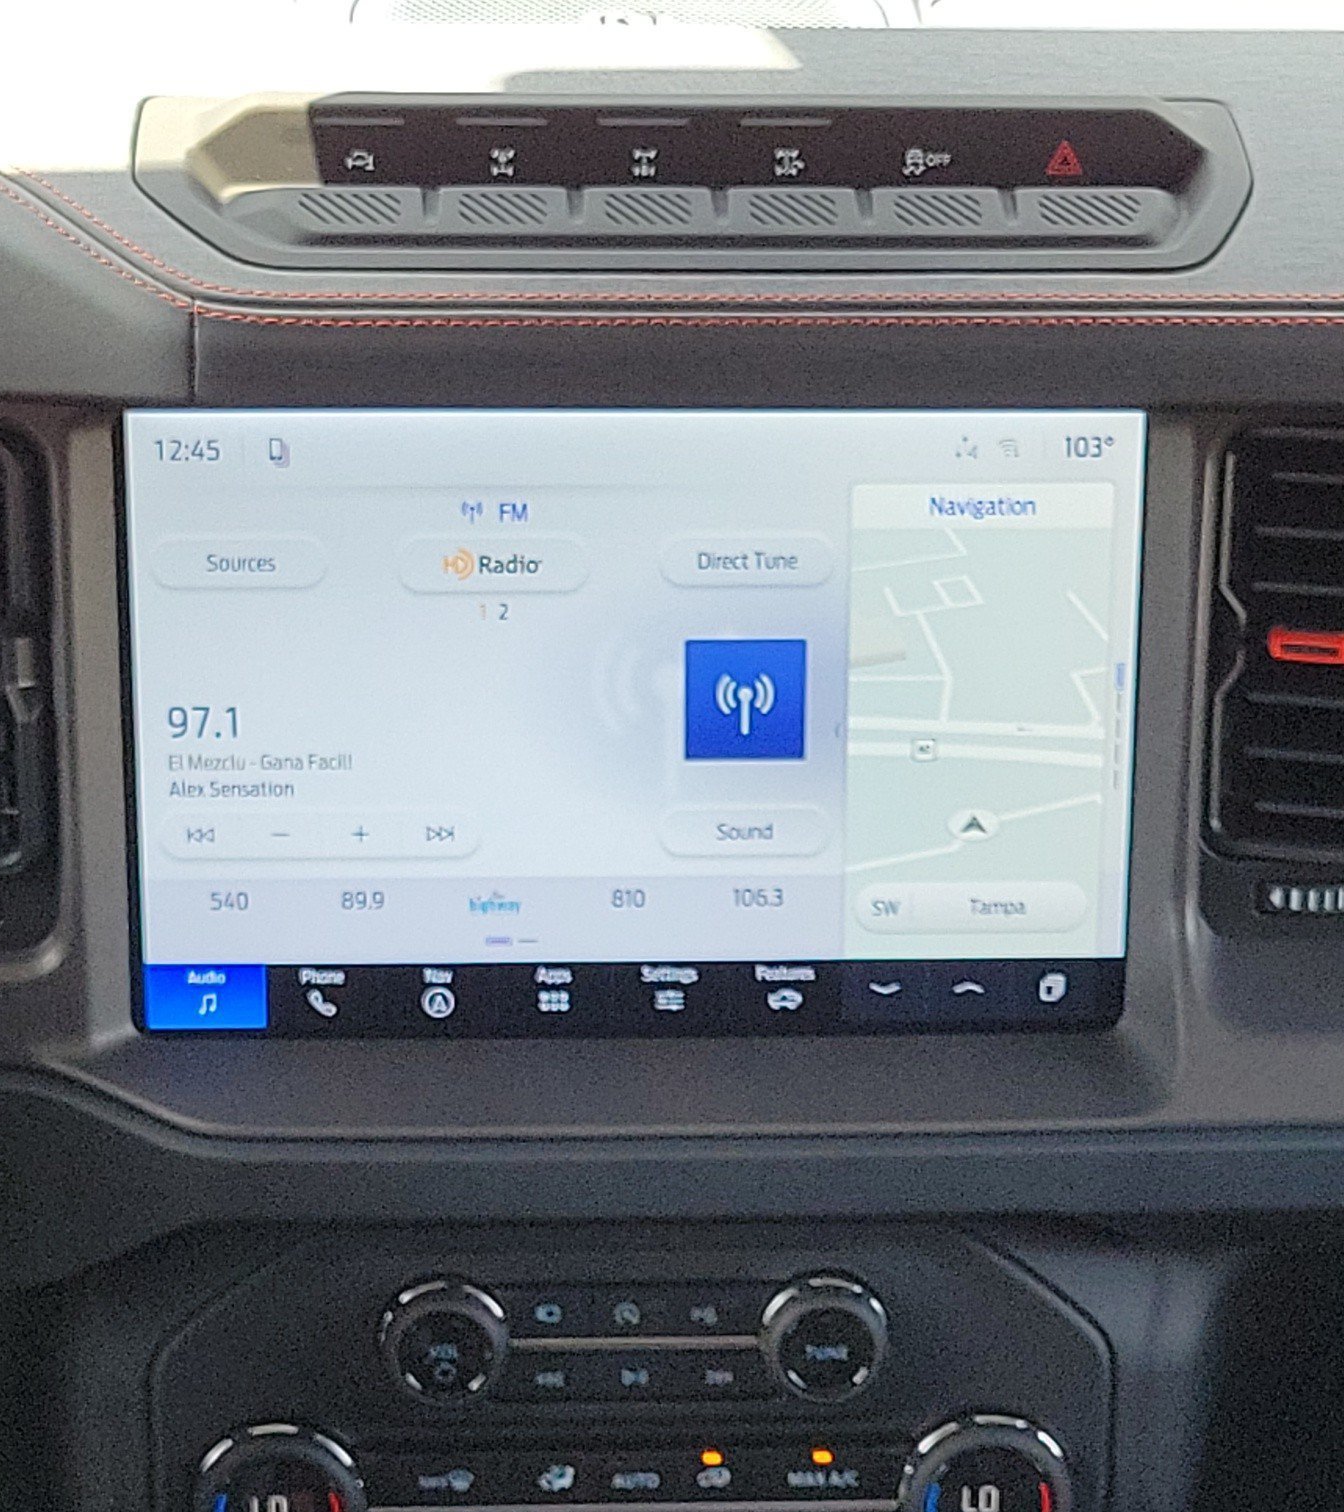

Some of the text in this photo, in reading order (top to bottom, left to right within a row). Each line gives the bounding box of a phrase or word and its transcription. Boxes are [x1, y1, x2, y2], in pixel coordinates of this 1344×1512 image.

[925, 153, 951, 166] OFF
[154, 438, 221, 463] 12:45
[499, 503, 529, 523] FM
[929, 495, 1037, 519] Navigation
[206, 553, 277, 573] Sources
[479, 553, 539, 575] Radio
[697, 551, 799, 571] Direct Tune
[498, 602, 510, 621] 2
[167, 705, 241, 740] 97.1
[168, 754, 183, 771] El
[260, 754, 304, 771] Gana
[169, 781, 295, 798] Alex Sensation
[716, 824, 774, 842] Sound
[210, 891, 250, 911] 540
[341, 891, 385, 910] 89.9
[611, 887, 647, 910] 810
[733, 888, 784, 908] 106.3
[970, 898, 1027, 918] Tampa
[872, 900, 902, 917] SW
[187, 970, 227, 986] Audio
[300, 968, 346, 986] Phone
[422, 968, 453, 985] Nav
[535, 966, 574, 986] Apps
[639, 965, 699, 986] Settings
